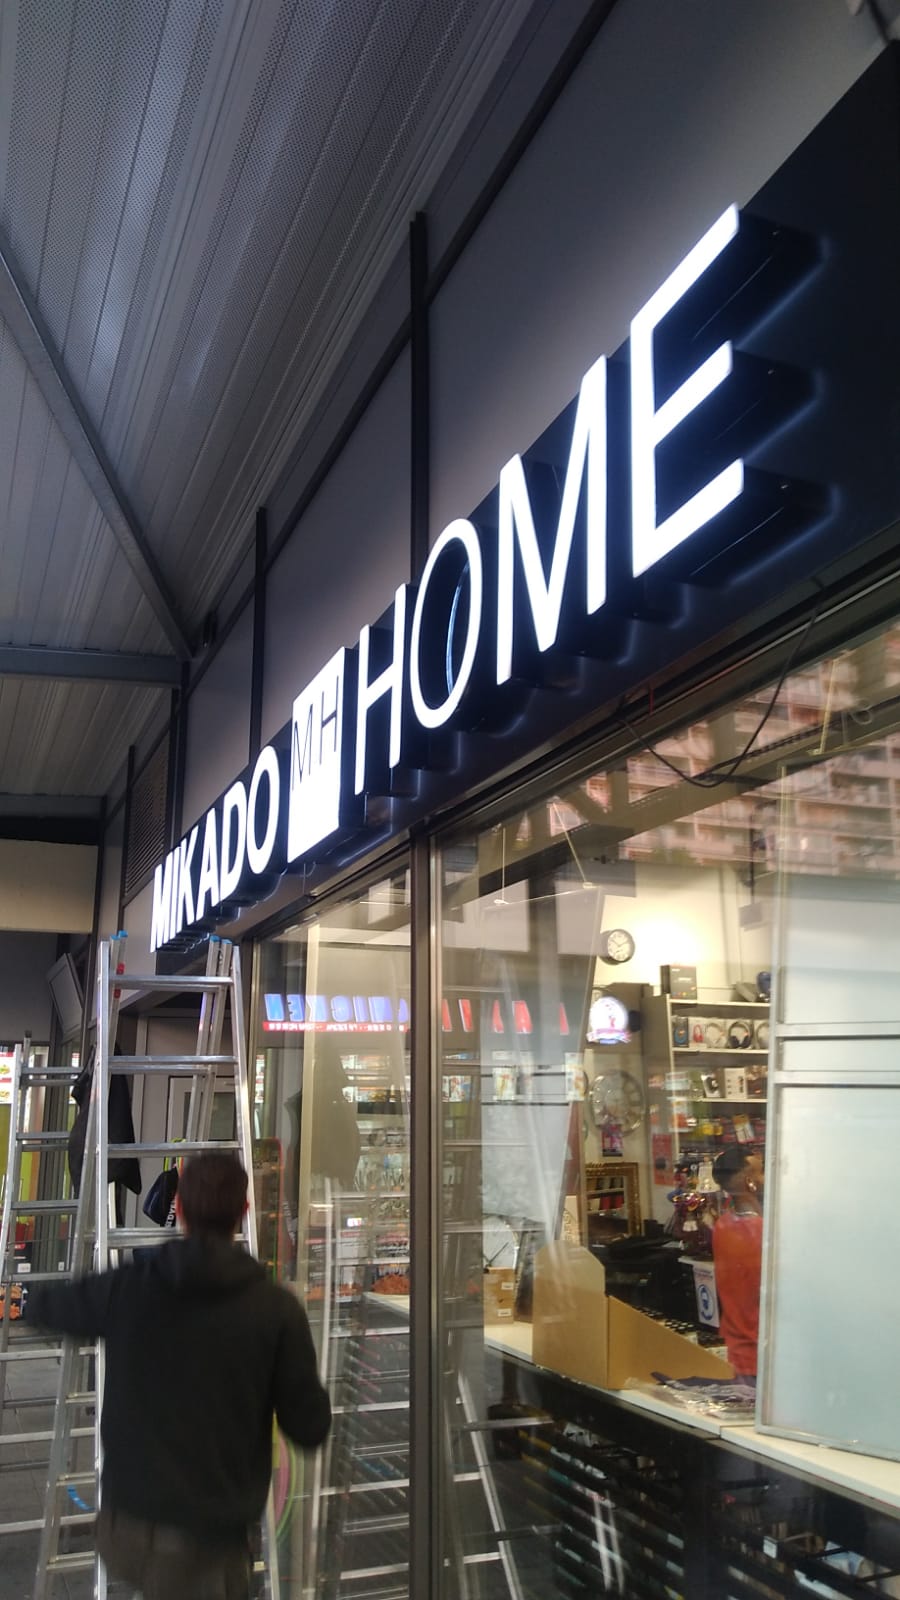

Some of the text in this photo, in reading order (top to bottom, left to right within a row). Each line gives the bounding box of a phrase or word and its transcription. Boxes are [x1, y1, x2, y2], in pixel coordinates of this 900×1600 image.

[150, 203, 744, 953] MIKADO MH HOME
